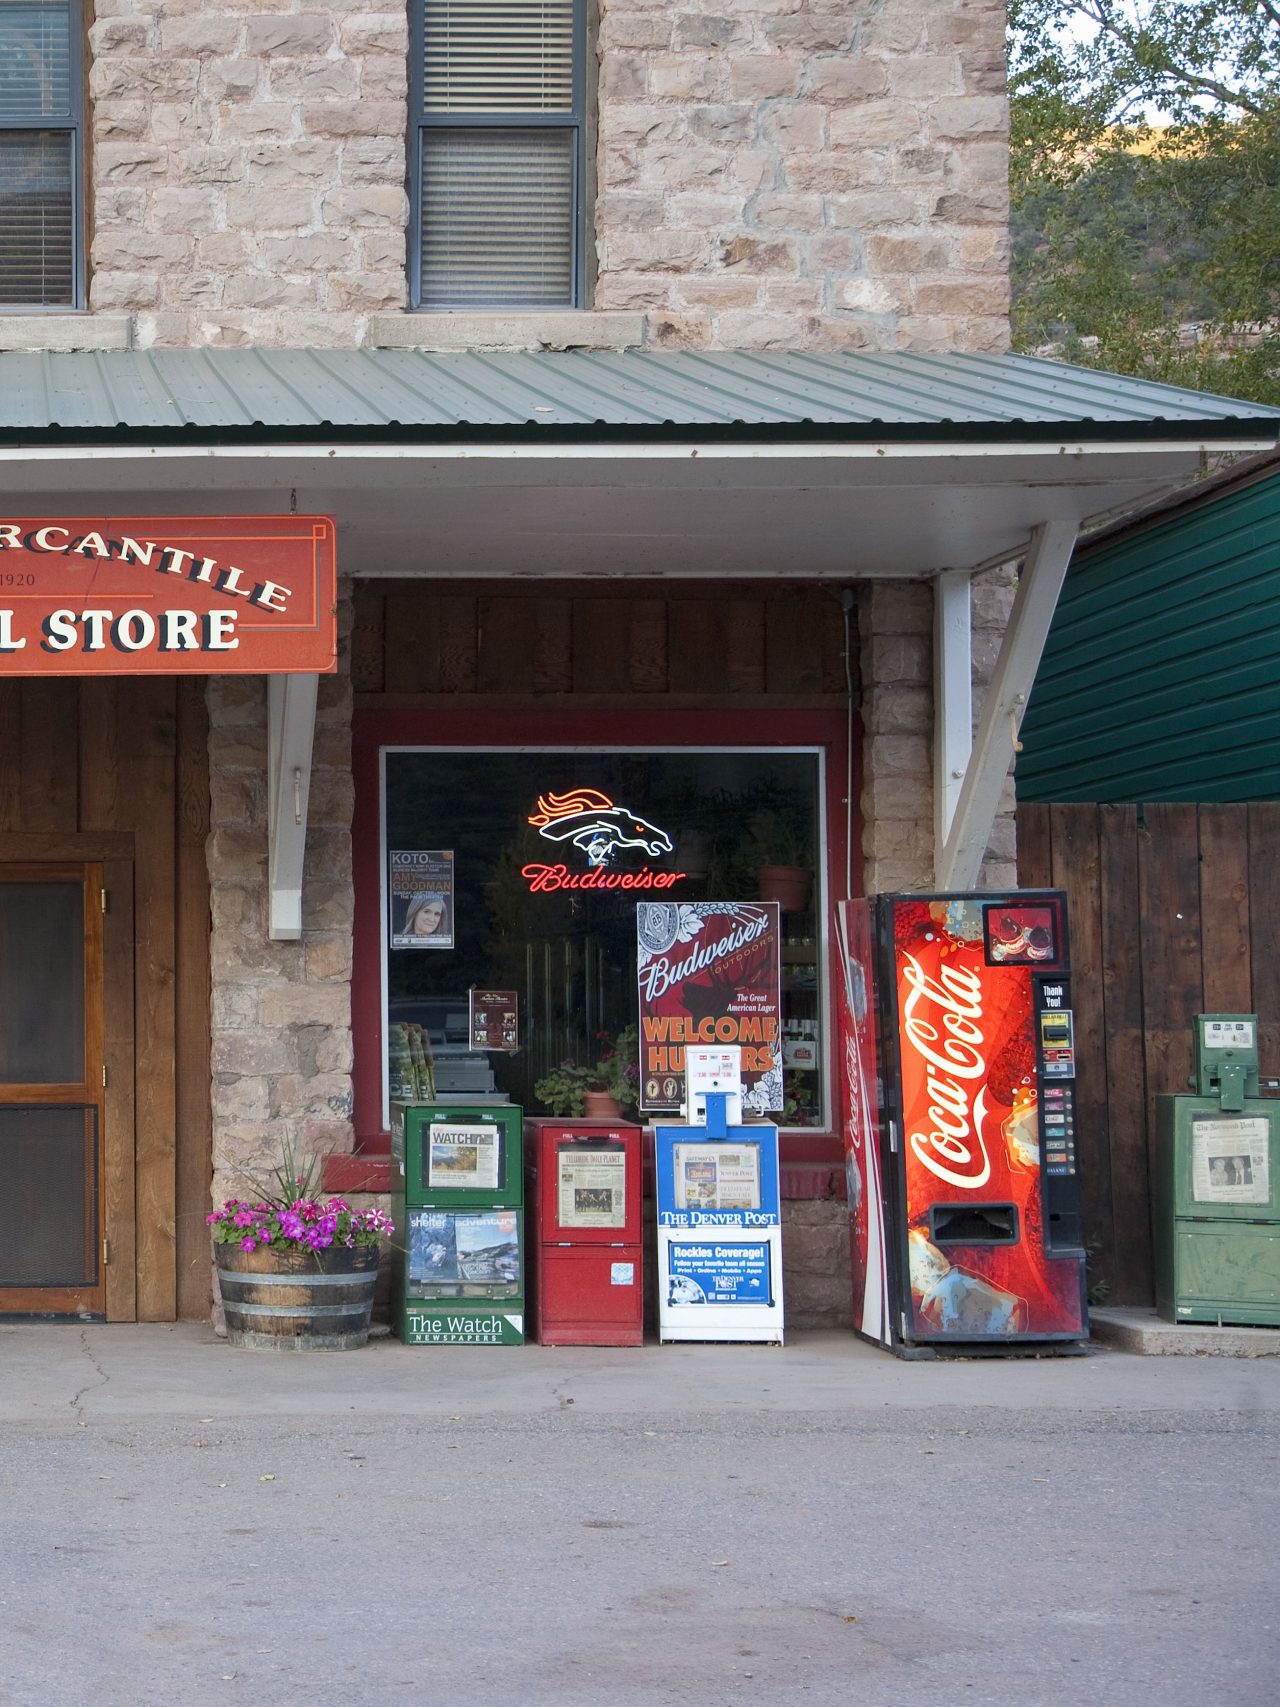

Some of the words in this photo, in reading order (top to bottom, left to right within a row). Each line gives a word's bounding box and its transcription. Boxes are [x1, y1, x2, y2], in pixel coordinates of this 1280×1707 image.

[47, 609, 240, 651] STORE
[392, 853, 429, 864] KOTO
[394, 873, 415, 881] AMY
[521, 864, 686, 892] Budweiser
[393, 882, 451, 890] GOODMAN
[639, 914, 769, 1002] Budweiser
[714, 934, 774, 974] OUTDOORS
[1043, 986, 1063, 996] Thank
[737, 993, 748, 1002] The
[749, 993, 767, 1002] Great
[1046, 997, 1061, 1007] You!
[727, 1004, 757, 1012] American
[758, 1004, 776, 1013] Lager
[642, 1017, 777, 1042] WELCOME
[648, 1046, 774, 1072] HURS
[902, 950, 991, 1189] Coca-Cola
[1240, 1120, 1256, 1129] Post
[433, 1133, 473, 1144] WATCH
[590, 1155, 602, 1163] DAILY
[603, 1155, 620, 1163] PLANET
[411, 1216, 446, 1227] shelter
[661, 1212, 688, 1224] THE
[691, 1212, 742, 1224] DENVER
[744, 1212, 776, 1224] POST
[674, 1247, 713, 1258] Rockies
[715, 1247, 764, 1260] Coverage!
[409, 1315, 442, 1333] The
[447, 1315, 503, 1333] Watch
